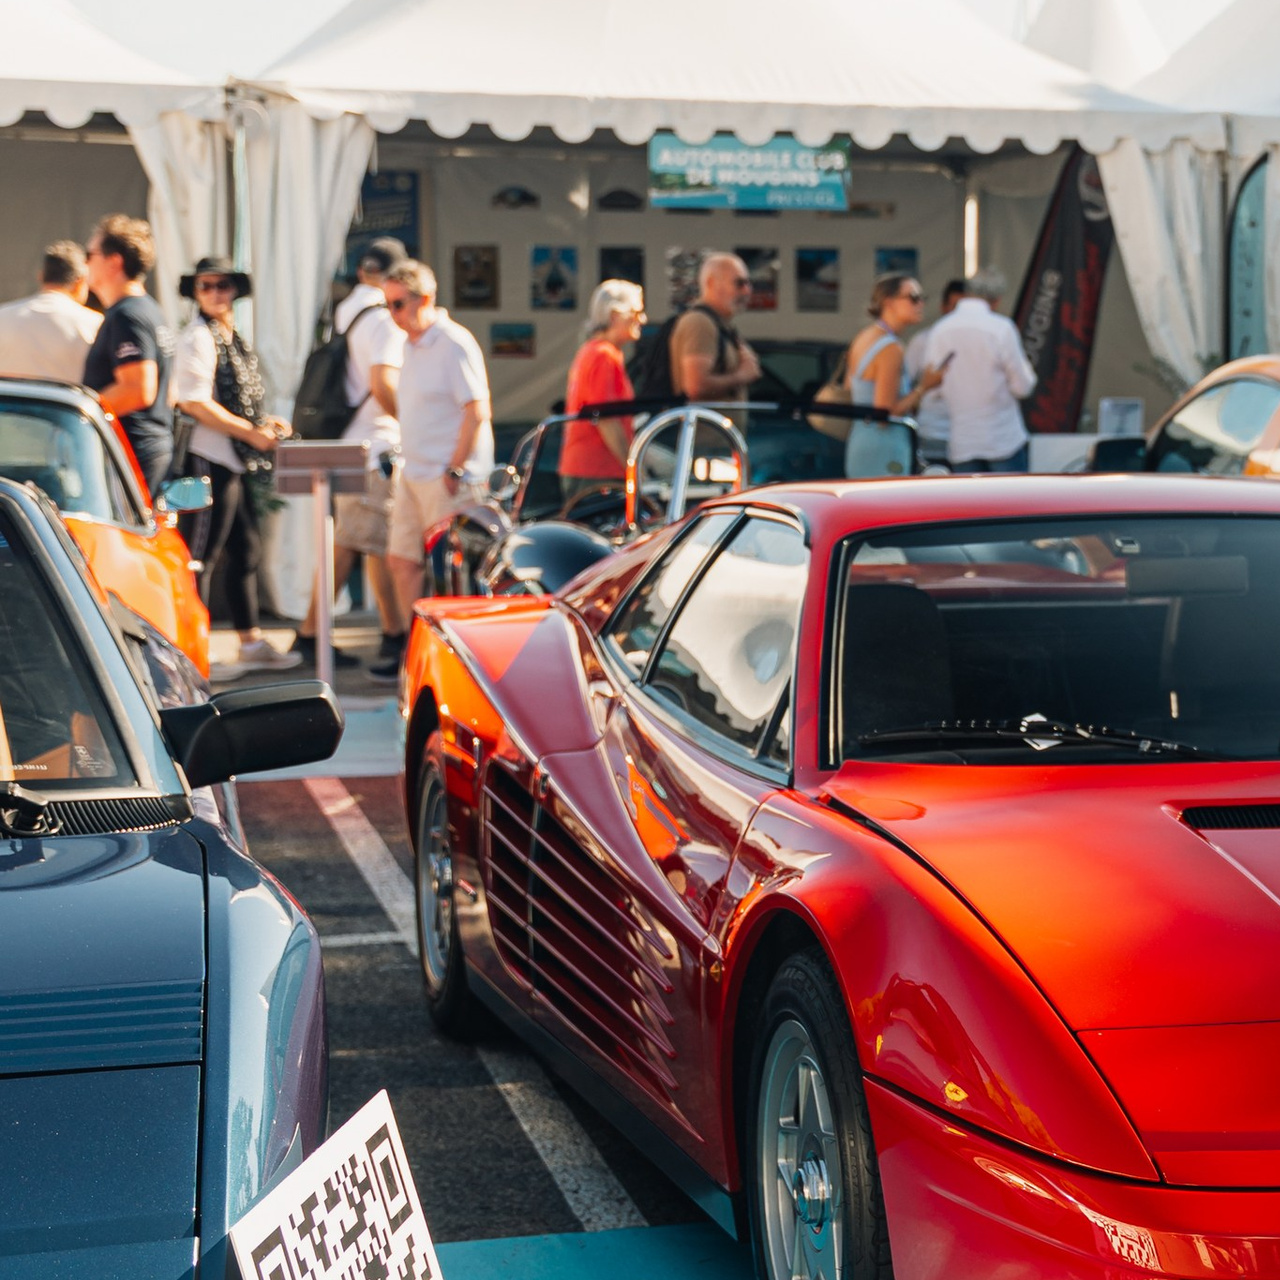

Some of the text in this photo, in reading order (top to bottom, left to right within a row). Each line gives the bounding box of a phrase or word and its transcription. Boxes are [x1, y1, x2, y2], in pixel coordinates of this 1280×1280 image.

[658, 149, 847, 170] AUTOMOBILE CLUB
[685, 169, 820, 187] DE MOUGINS
